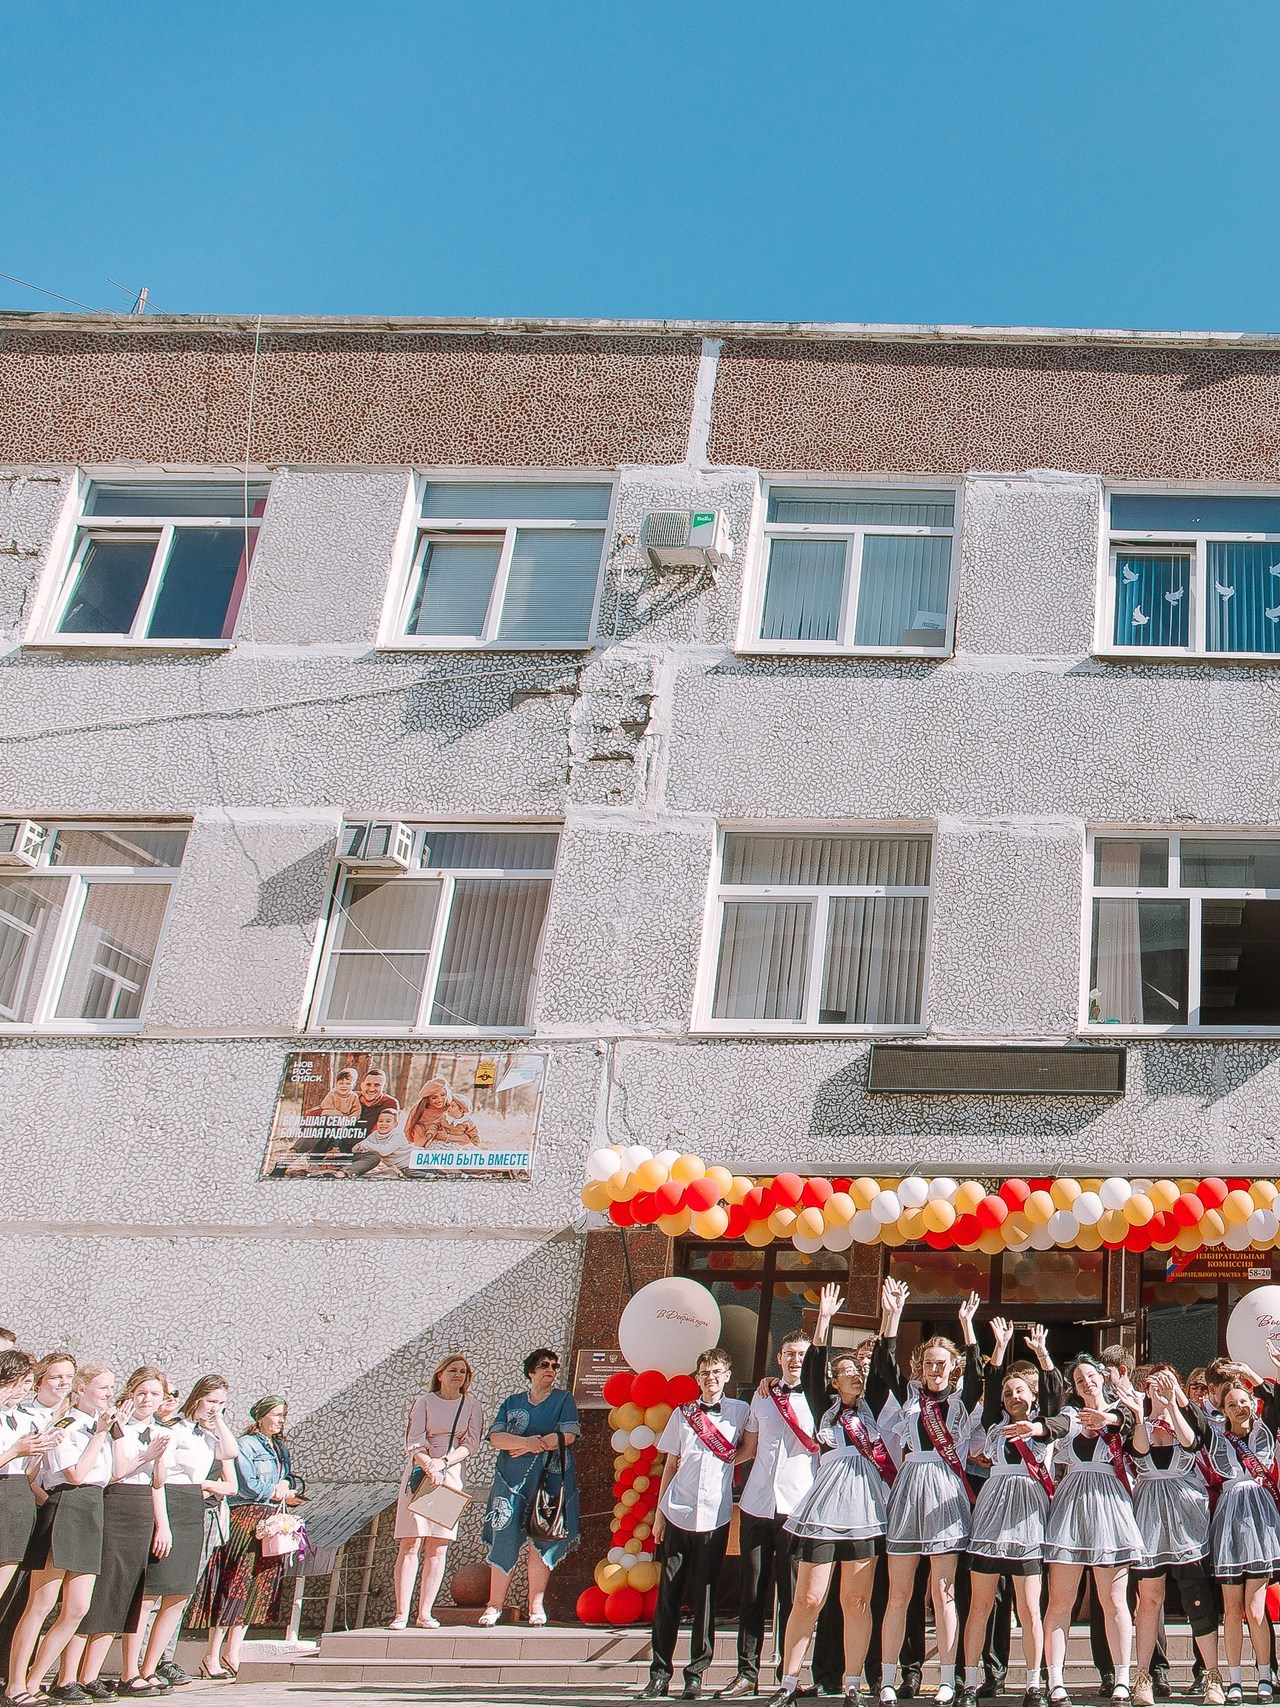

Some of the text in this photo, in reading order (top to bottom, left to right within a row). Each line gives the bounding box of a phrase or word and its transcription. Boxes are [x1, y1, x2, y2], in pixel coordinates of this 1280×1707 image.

[282, 1115, 326, 1127] БОЛЬШАЯ
[326, 1115, 356, 1127] СЕМЬЯ
[281, 1127, 367, 1139] БОЛЬШАЯ РАДОСТЬ!
[416, 1153, 529, 1166] ВАЖНО БЫТЬ ВМЕСТЕ
[1249, 1268, 1271, 1277] 58-20
